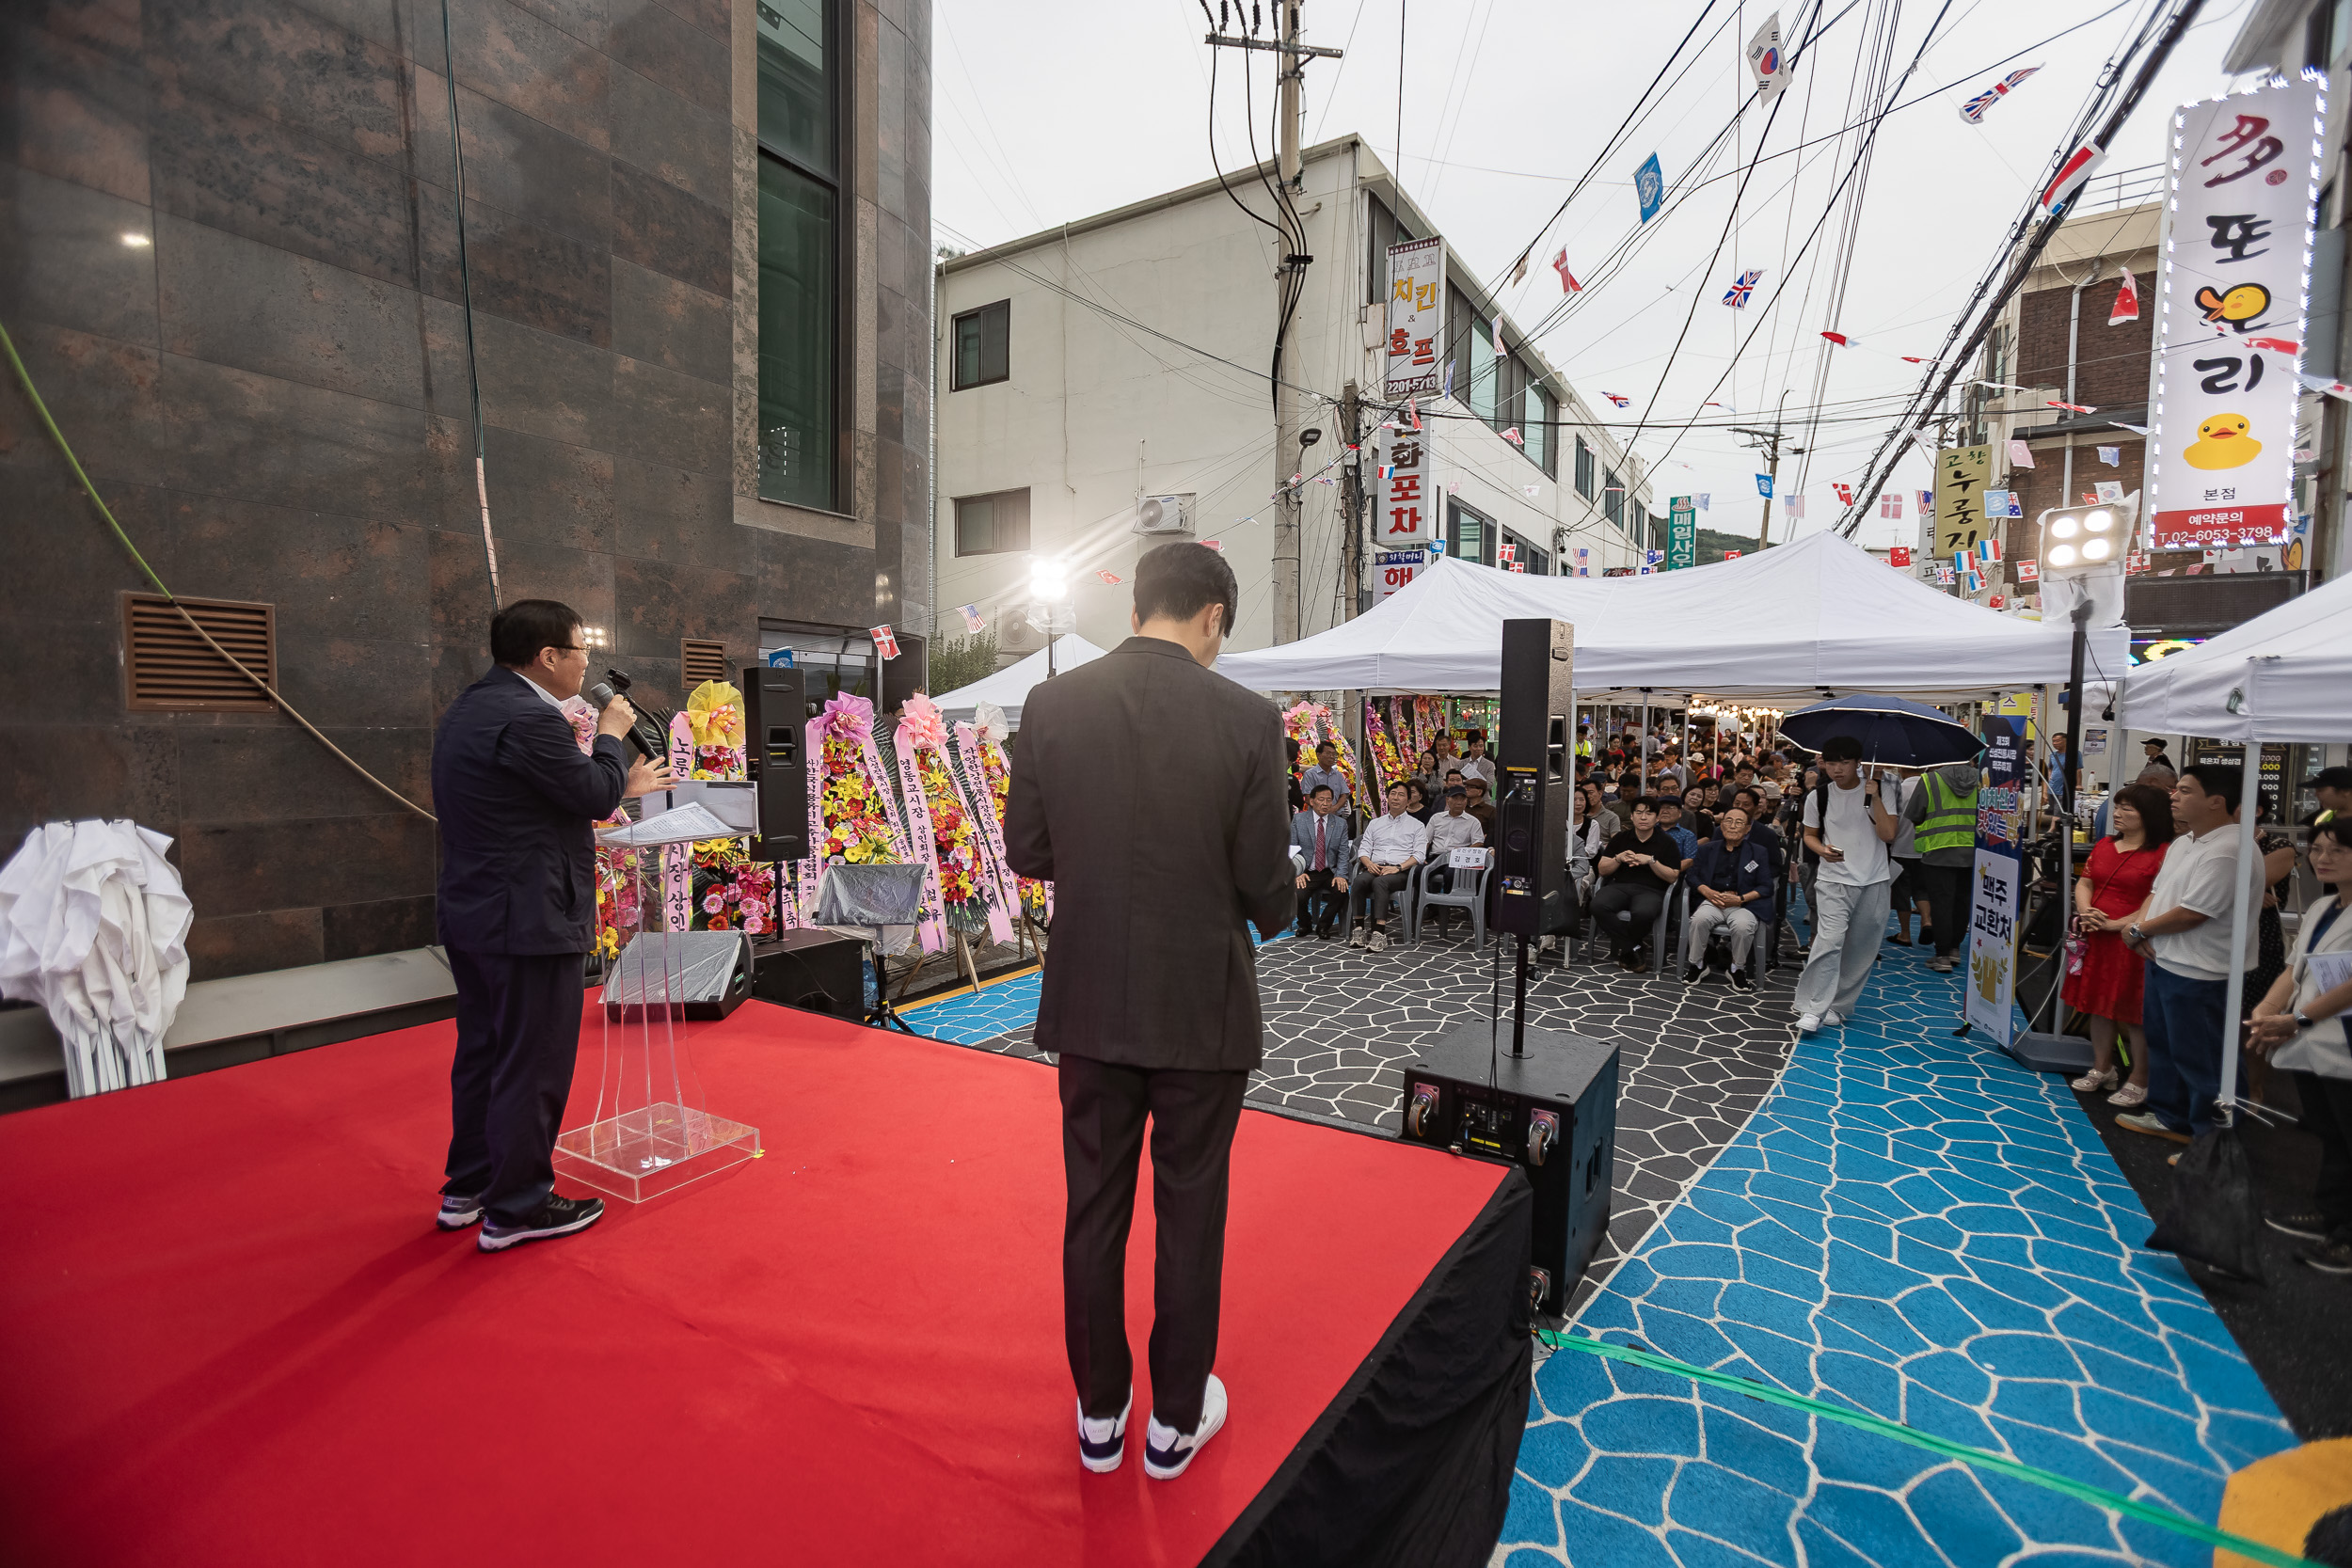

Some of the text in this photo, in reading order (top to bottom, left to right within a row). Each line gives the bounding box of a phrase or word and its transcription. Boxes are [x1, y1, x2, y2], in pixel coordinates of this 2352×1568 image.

[2201, 114, 2283, 188] 多
[1392, 277, 1437, 312] 치킨
[1388, 328, 1436, 366] 호프
[1388, 376, 1436, 394] 2201-5713
[1945, 450, 1987, 469] 고향
[1944, 470, 1980, 549] 누룽지
[2203, 487, 2236, 501] 본점
[2159, 526, 2273, 544] T.02-6053-3798
[2188, 511, 2244, 526] 예약문의
[1671, 513, 1693, 571] 매일사우
[899, 758, 926, 819] 영동교시장
[917, 825, 931, 863] 상인회장
[1979, 786, 2019, 815] 아차산의
[1977, 808, 2008, 840] 맛있는
[1982, 874, 2008, 907] 맥주
[1974, 903, 2012, 943] 교환처
